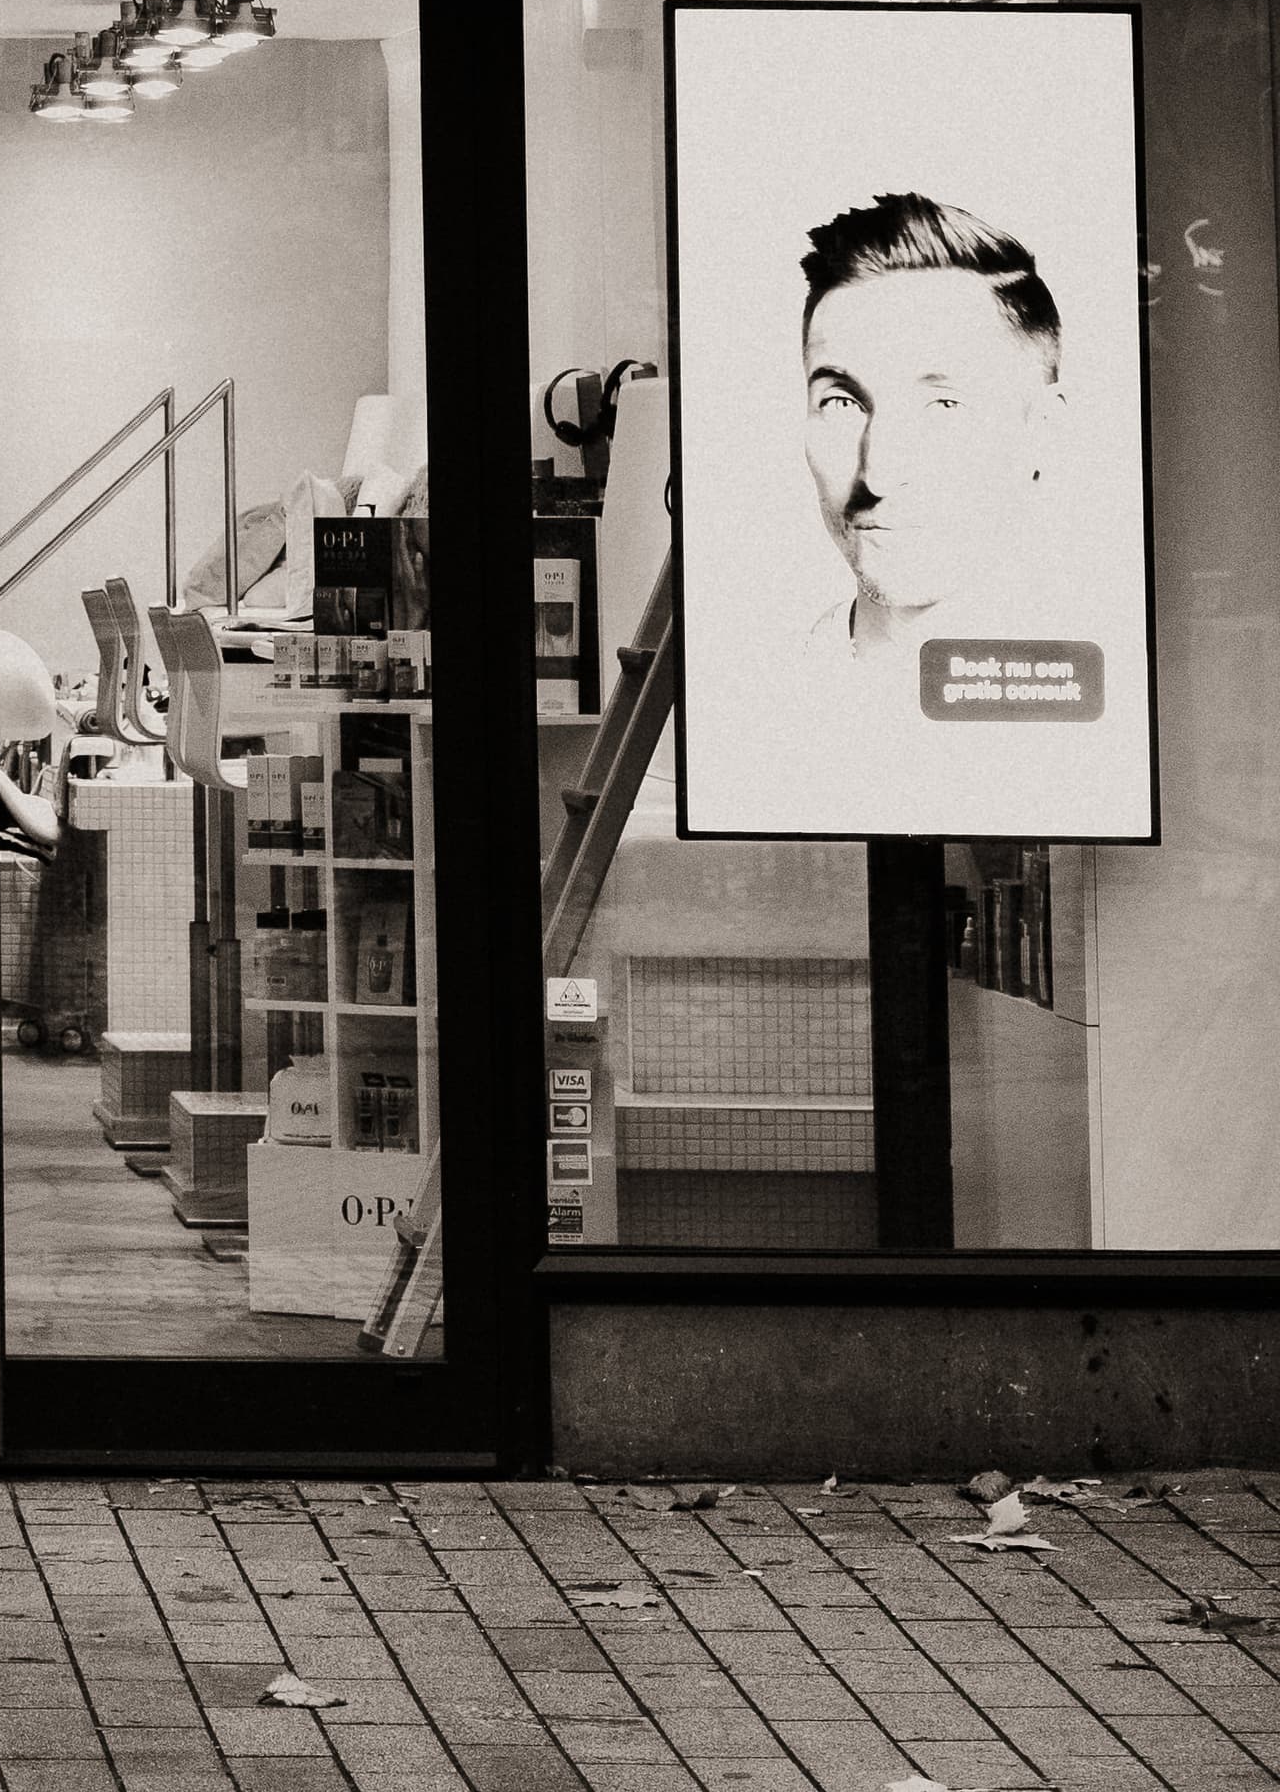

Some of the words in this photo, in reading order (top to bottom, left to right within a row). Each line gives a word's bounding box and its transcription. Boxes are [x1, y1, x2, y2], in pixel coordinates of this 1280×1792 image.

[1004, 661, 1032, 678] nu
[943, 679, 1003, 704] gratis
[1005, 680, 1082, 701] consult
[556, 1075, 585, 1086] VISA
[549, 1206, 582, 1216] Alarm
